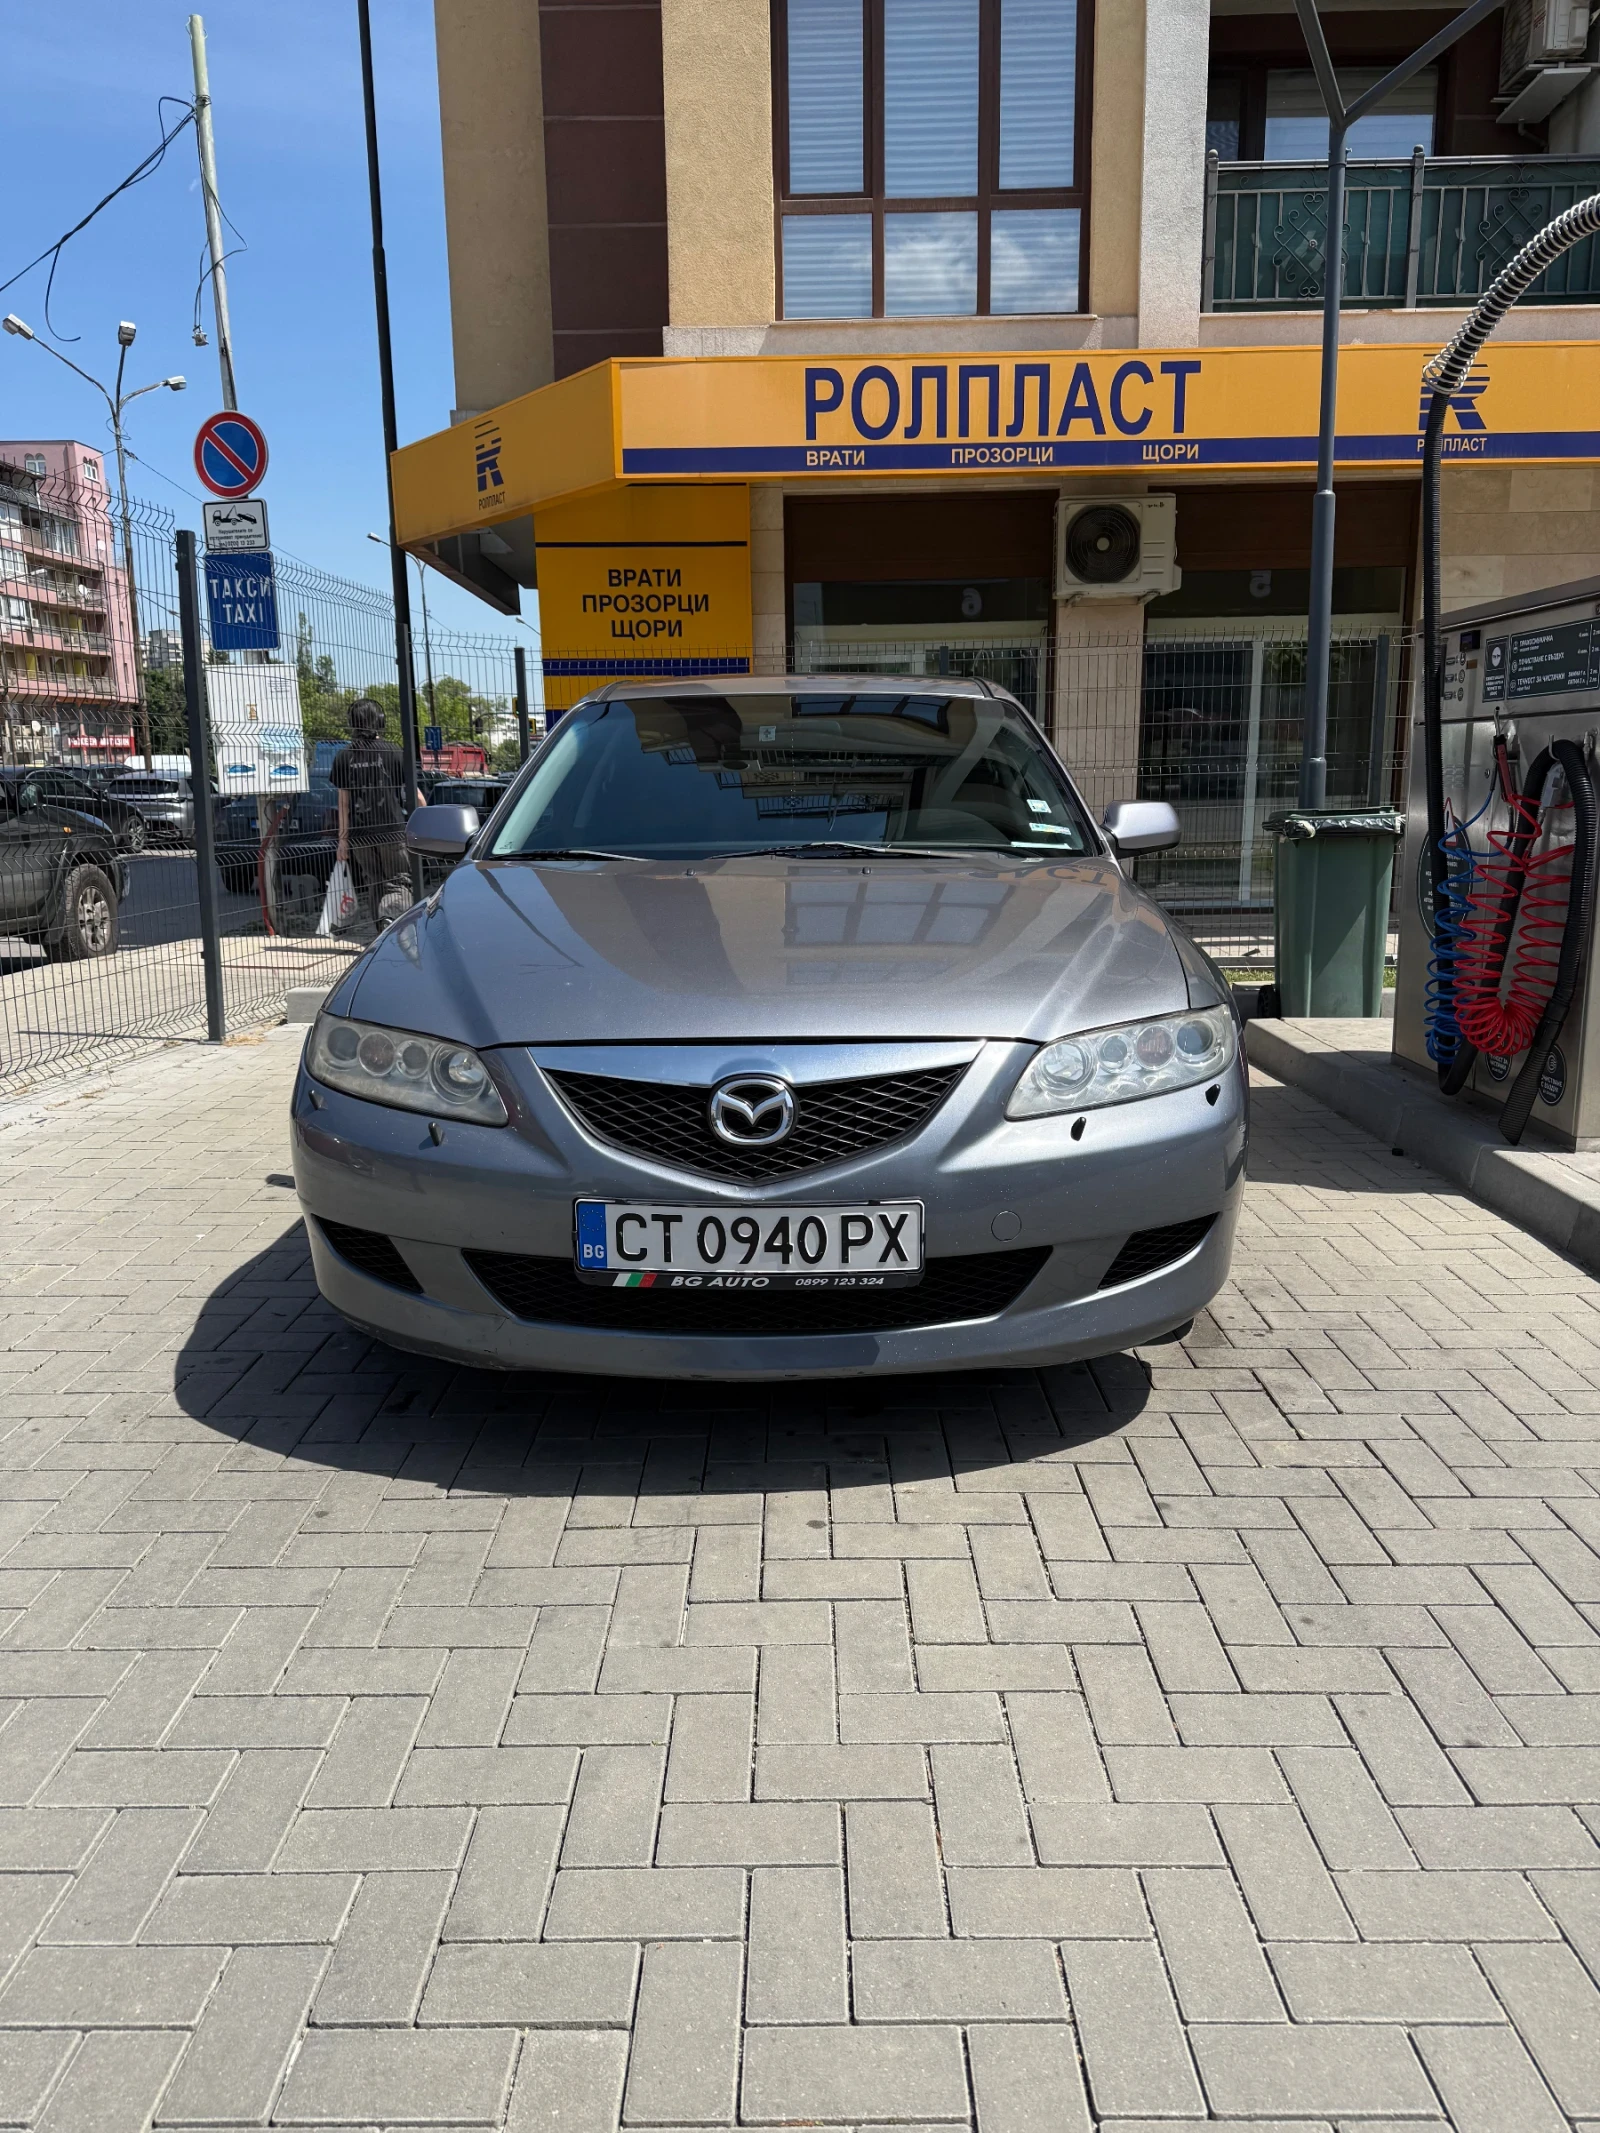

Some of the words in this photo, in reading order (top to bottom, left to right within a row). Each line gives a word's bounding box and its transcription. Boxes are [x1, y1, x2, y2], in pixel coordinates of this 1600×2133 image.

[804, 360, 1202, 441] РОЛПЛАСТ
[806, 449, 865, 466] ВРАТИ
[951, 446, 1054, 465] ПРОЗОРЦИ
[1142, 444, 1199, 462] ЩОРИ
[1417, 437, 1487, 452] РПЛАСТ
[209, 576, 271, 599] ТАКСИ
[607, 568, 682, 588] ВРАТИ
[222, 602, 264, 624] TAXI
[582, 594, 709, 616] ПРОЗОРЦИ
[611, 619, 683, 641] ЩОРИ
[15, 739, 41, 751] РАТИ
[696, 1214, 828, 1265] 0940
[583, 1243, 605, 1259] BG
[670, 1275, 704, 1288] BG
[705, 1275, 770, 1288] AUTO
[795, 1277, 829, 1286] 0899
[832, 1277, 856, 1286] 123
[857, 1276, 885, 1286] 324
